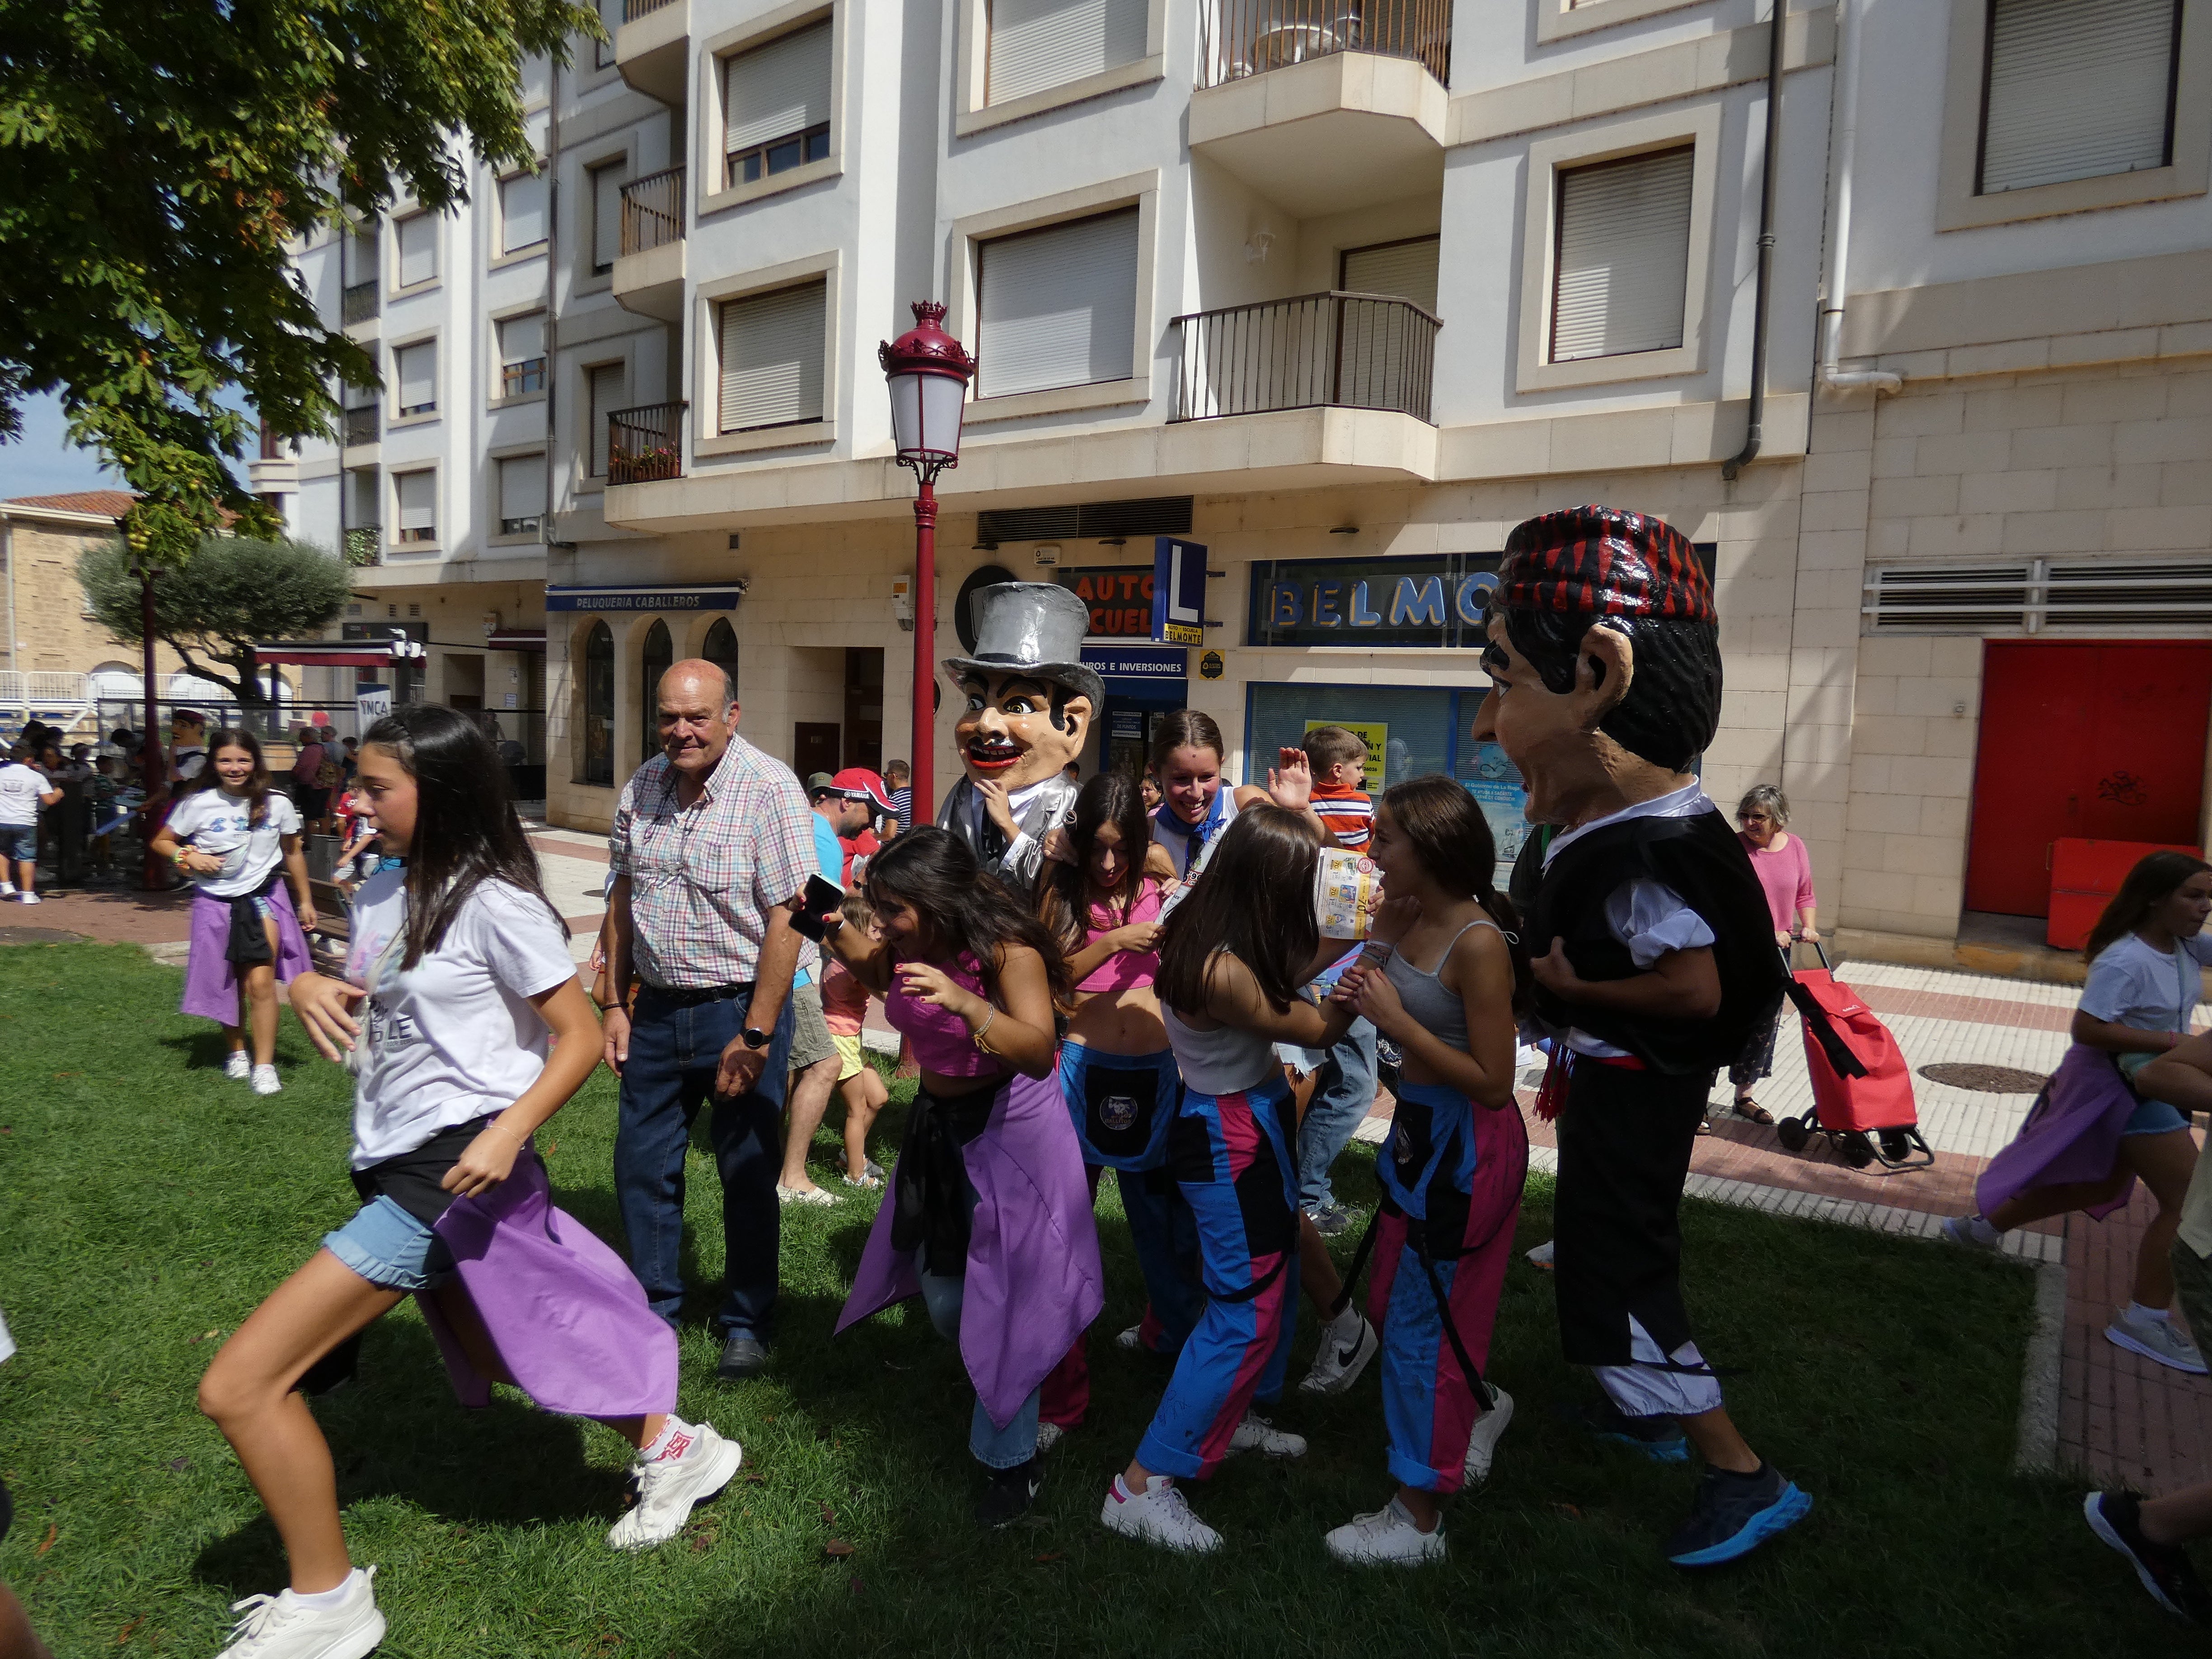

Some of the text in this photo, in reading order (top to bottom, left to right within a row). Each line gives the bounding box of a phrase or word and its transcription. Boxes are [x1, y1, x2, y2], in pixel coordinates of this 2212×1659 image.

[1169, 545, 1198, 623] L
[576, 596, 700, 609] PELUQUERIA CABALLEROS
[1270, 572, 1499, 627] BELMO
[1089, 608, 1152, 633] CUEL
[1165, 630, 1201, 643] BELMONTE
[1120, 663, 1181, 672] INVERSIONES
[361, 701, 388, 716] YMCA
